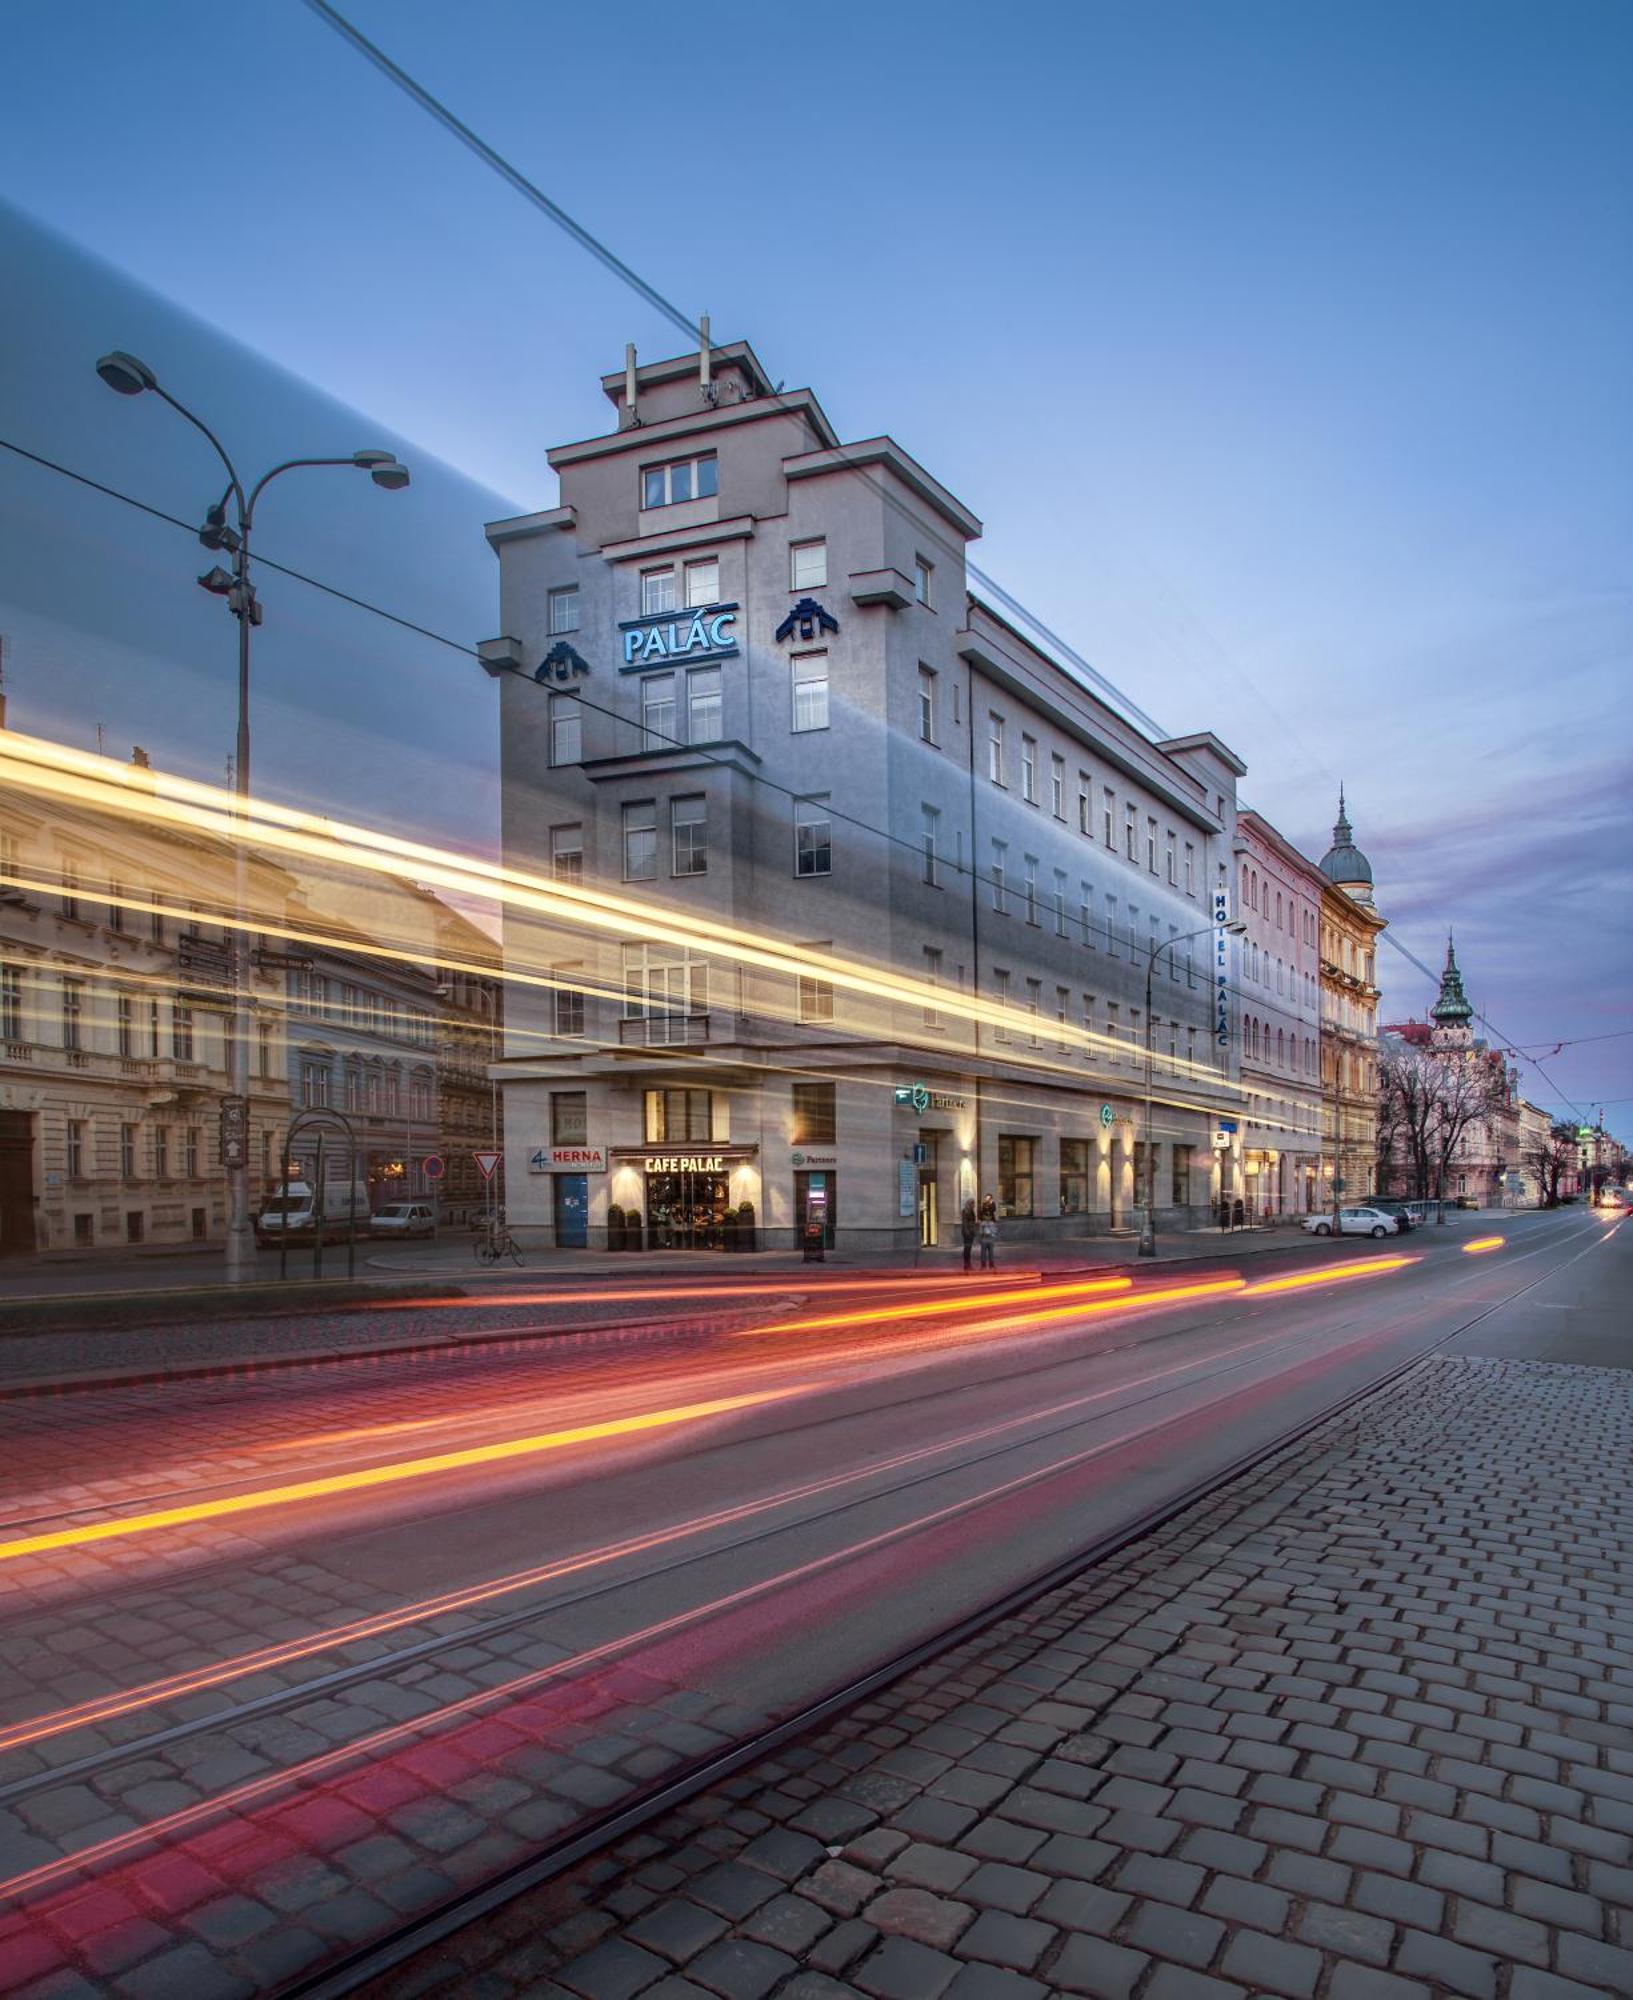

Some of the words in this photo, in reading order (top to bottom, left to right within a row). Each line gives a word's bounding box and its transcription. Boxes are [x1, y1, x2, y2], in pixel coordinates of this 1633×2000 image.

[624, 607, 736, 662] PALÁC
[1217, 975, 1228, 1046] PALÁC
[553, 1151, 601, 1163] HERNA
[645, 1158, 679, 1173] CAFE
